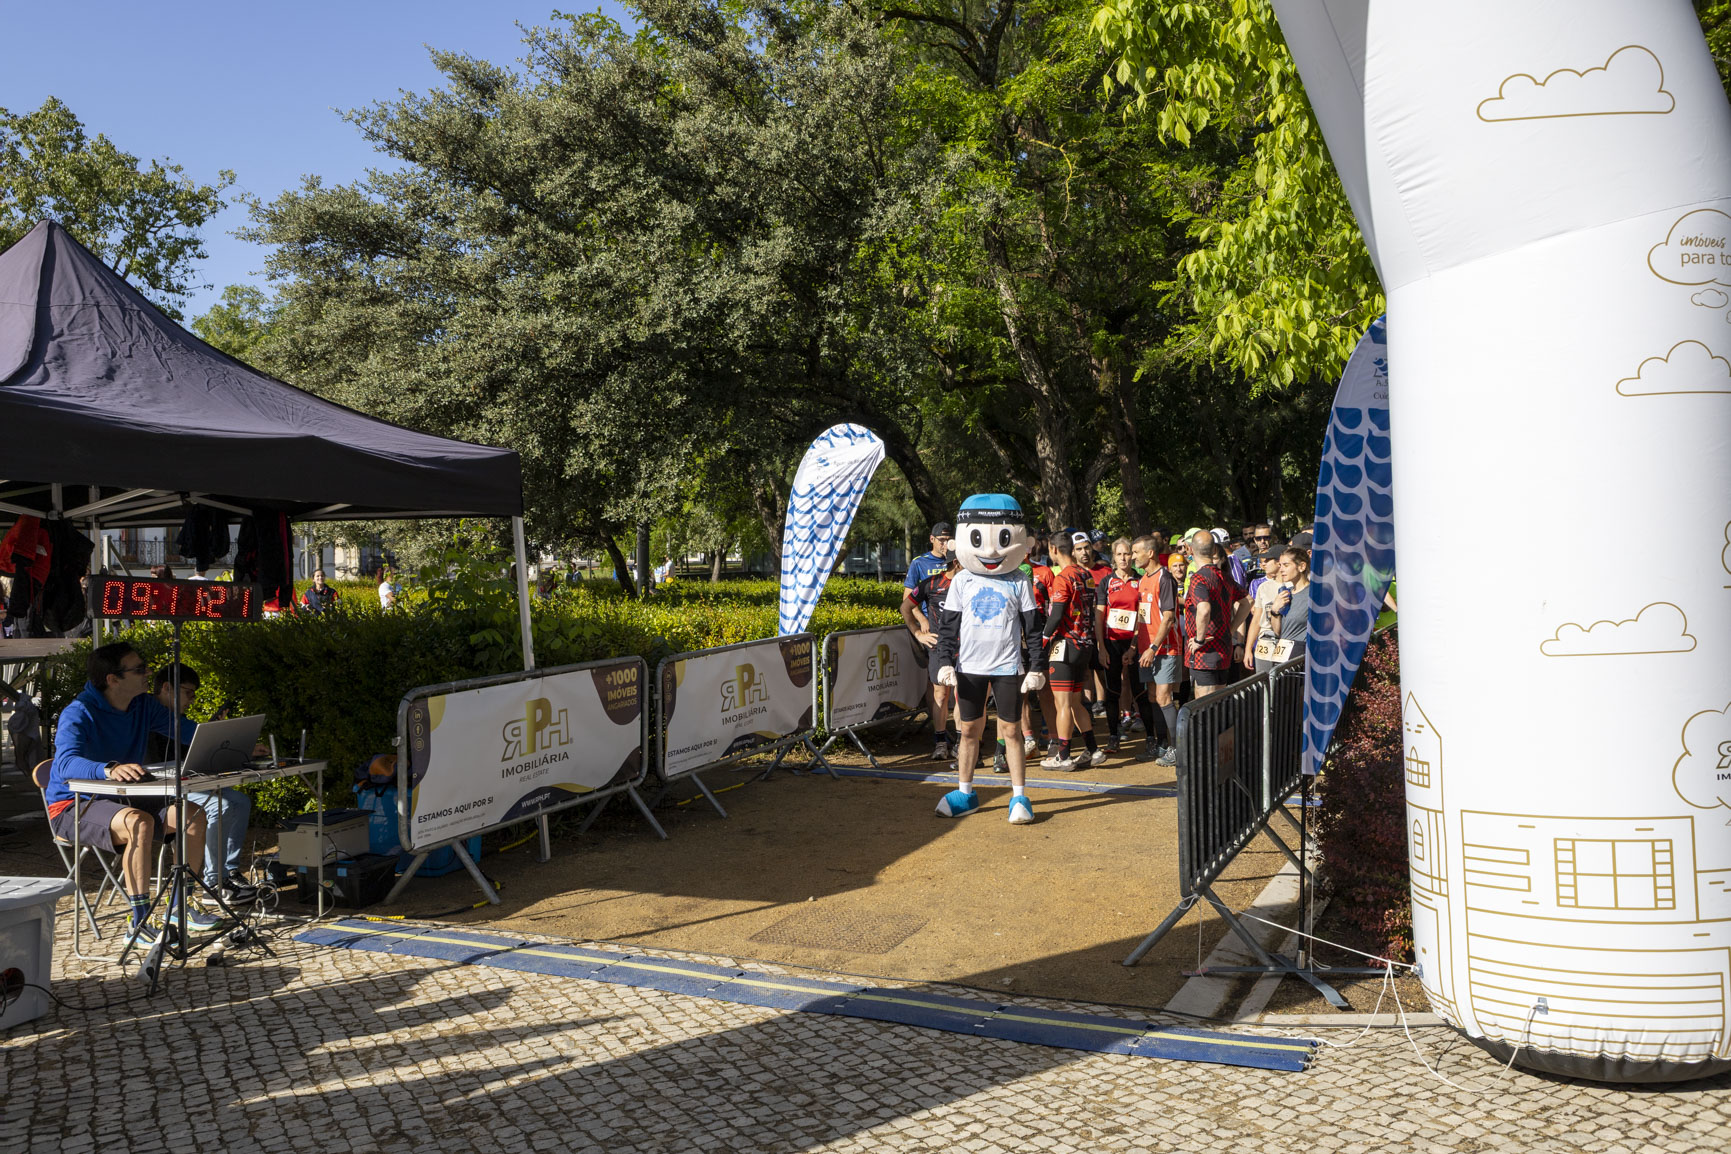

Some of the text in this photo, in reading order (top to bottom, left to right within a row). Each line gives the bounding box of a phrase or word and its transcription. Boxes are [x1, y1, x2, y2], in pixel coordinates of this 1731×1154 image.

[1681, 233, 1726, 248] imóveis
[1681, 252, 1715, 267] para
[102, 581, 250, 618] 09:11:21
[605, 667, 638, 685] +1000
[607, 685, 638, 702] IMÓVEIS
[722, 706, 767, 725] IMOBILIÁRIA
[667, 746, 691, 758] ESTAMOS
[691, 742, 703, 751] AQUI
[501, 751, 570, 779] IMOBILIÁRIA
[418, 796, 494, 823] ESTAMOS AQUI POR SI
